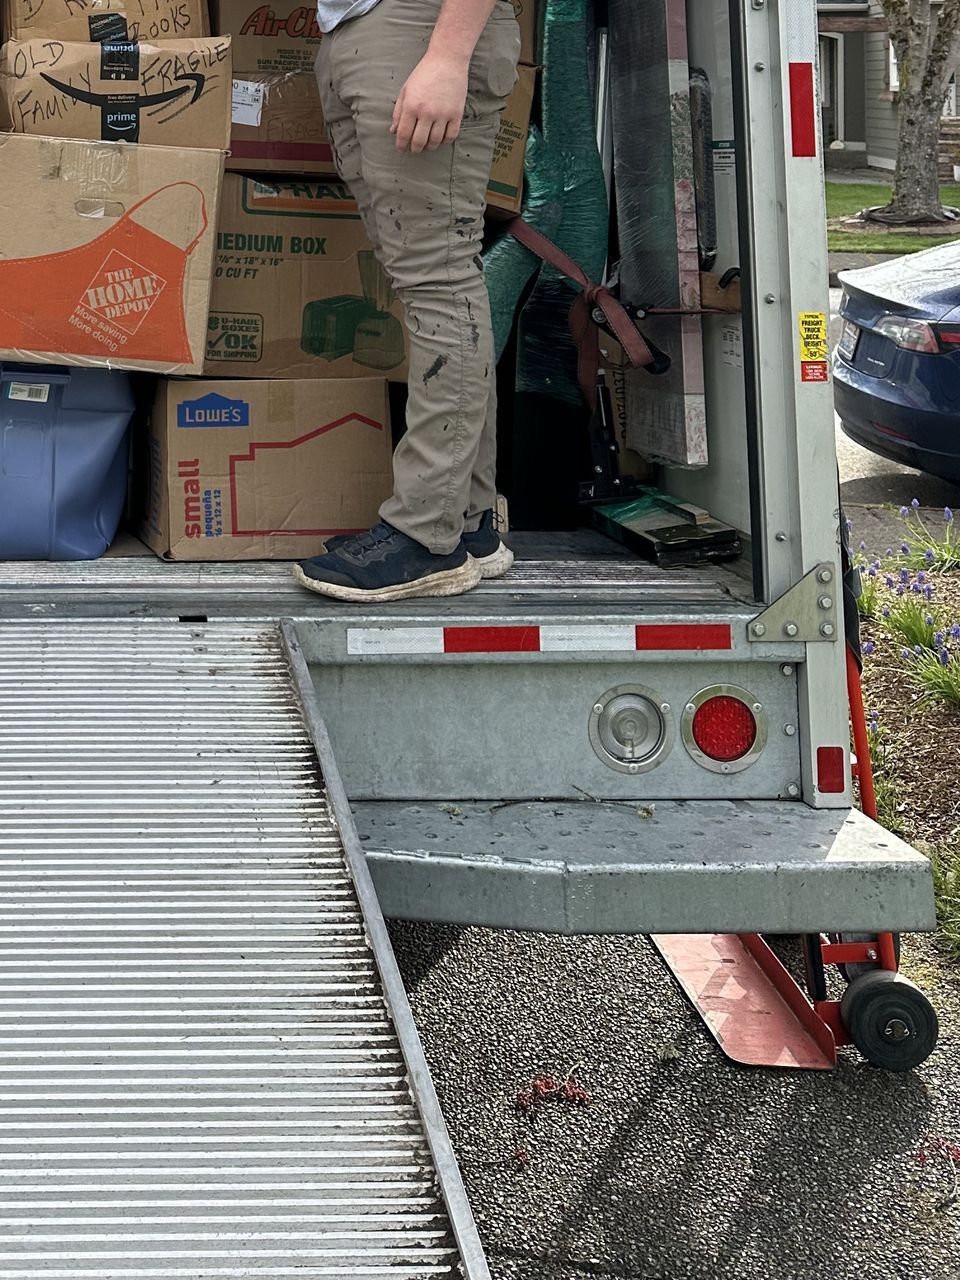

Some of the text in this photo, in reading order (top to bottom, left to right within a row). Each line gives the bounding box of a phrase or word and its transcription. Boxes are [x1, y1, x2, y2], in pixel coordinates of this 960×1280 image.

[128, 3, 192, 41] BOOKS
[13, 41, 64, 79] OLD
[107, 112, 137, 123] prime
[290, 236, 327, 255] BOX
[104, 267, 135, 284] THE
[225, 267, 241, 278] CU
[244, 268, 259, 279] FT
[87, 273, 161, 309] HOME
[104, 297, 151, 319] DEPOT
[68, 315, 118, 352] More doing.
[74, 305, 128, 345] More saving.
[221, 324, 260, 332] BOXES
[224, 333, 257, 350] OK
[185, 406, 241, 423] LOWE'S
[177, 458, 201, 539] small
[213, 489, 221, 500] 12
[214, 507, 222, 518] 12
[214, 526, 222, 537] 16
